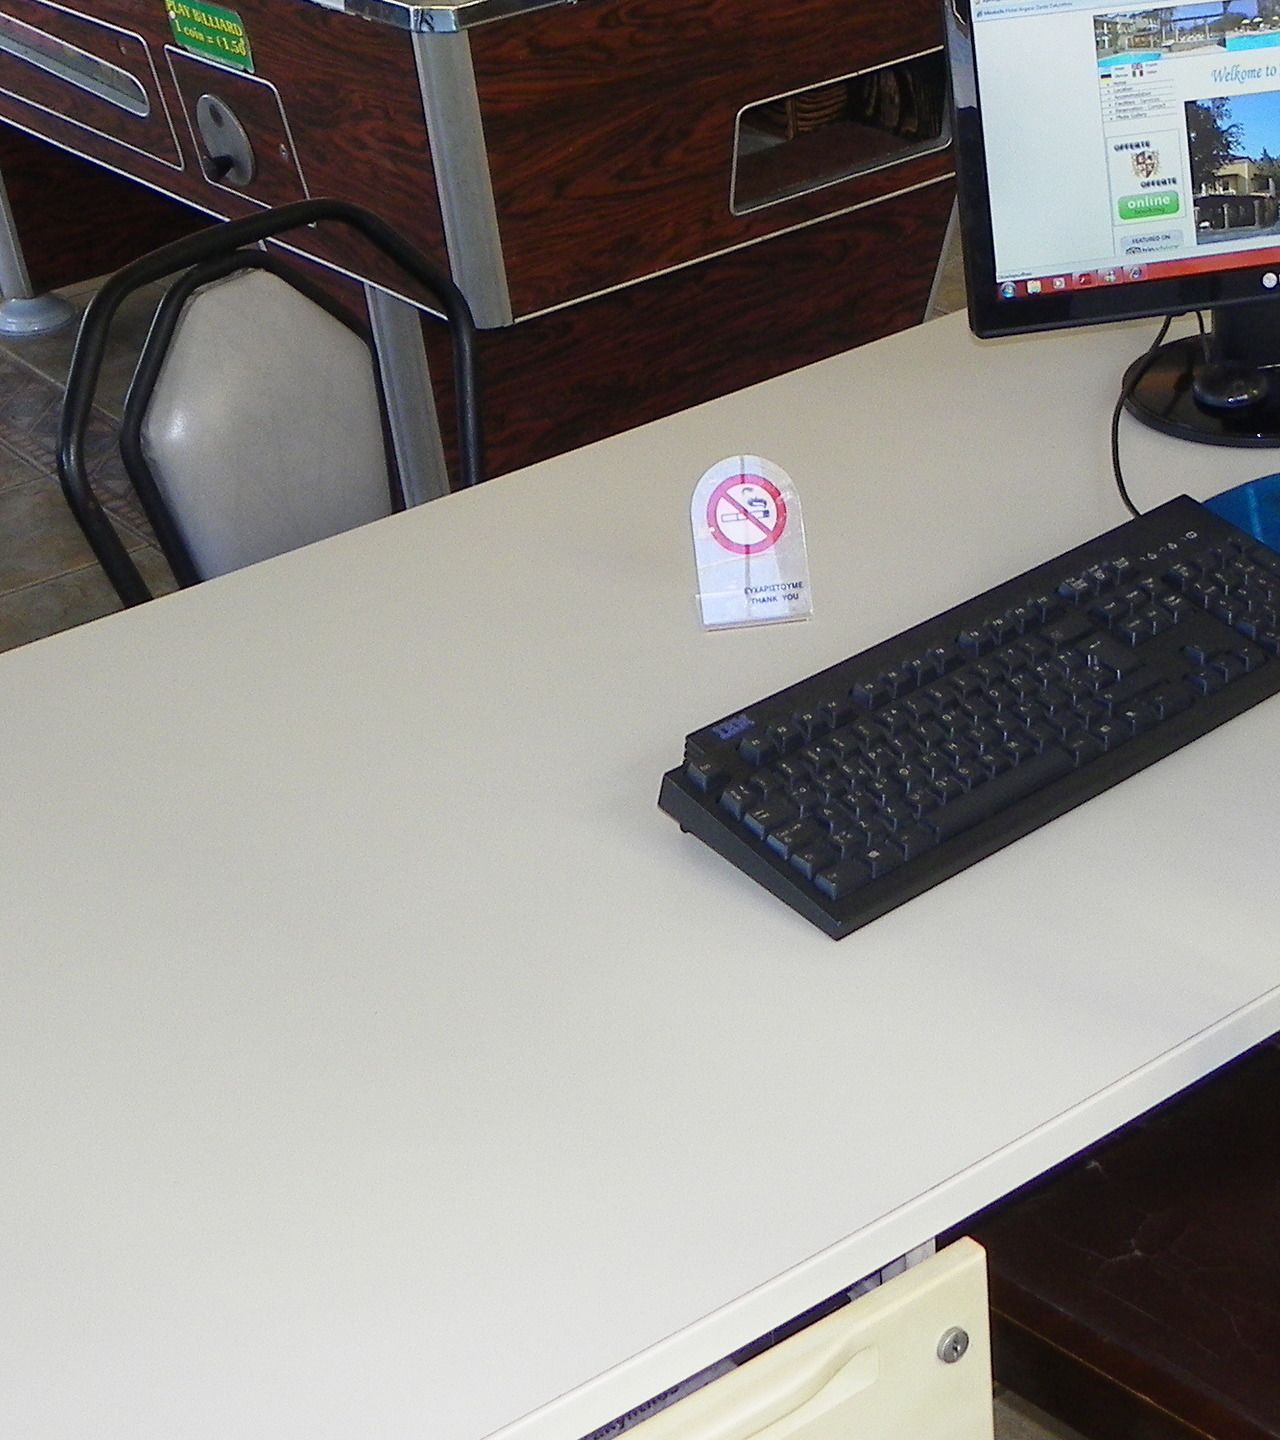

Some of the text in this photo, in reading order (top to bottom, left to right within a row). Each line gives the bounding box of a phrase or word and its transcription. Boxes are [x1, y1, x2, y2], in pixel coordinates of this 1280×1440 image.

[191, 8, 243, 36] BILLIARD
[174, 19, 182, 33] 1
[183, 26, 205, 43] coin
[1265, 64, 1277, 77] to
[1127, 195, 1170, 209] online
[744, 581, 804, 595] ΕΥΧΑΡΙΣΤΟΥΜΕ
[751, 592, 800, 605] THANK YOU
